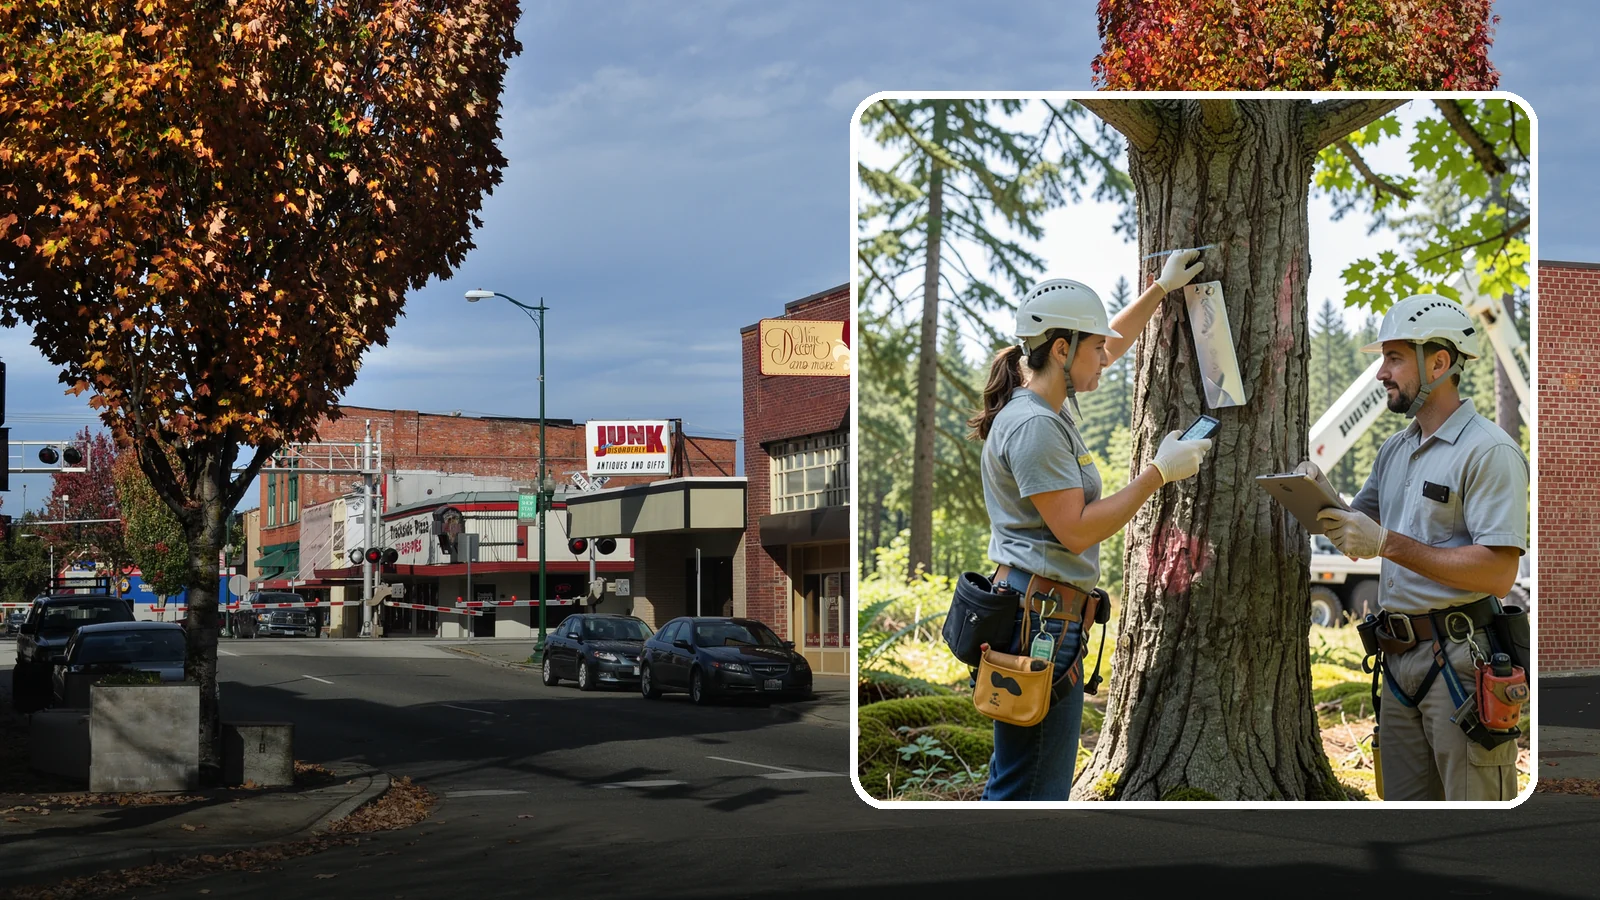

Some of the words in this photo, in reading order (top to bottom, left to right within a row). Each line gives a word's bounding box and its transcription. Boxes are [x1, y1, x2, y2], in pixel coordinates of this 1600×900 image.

[595, 425, 665, 457] JUNK
[607, 446, 646, 454] DISORDERLY
[597, 461, 628, 470] ANTIQUES
[631, 461, 643, 469] AND
[647, 461, 665, 469] GIFTS
[415, 520, 428, 534] Pizza
